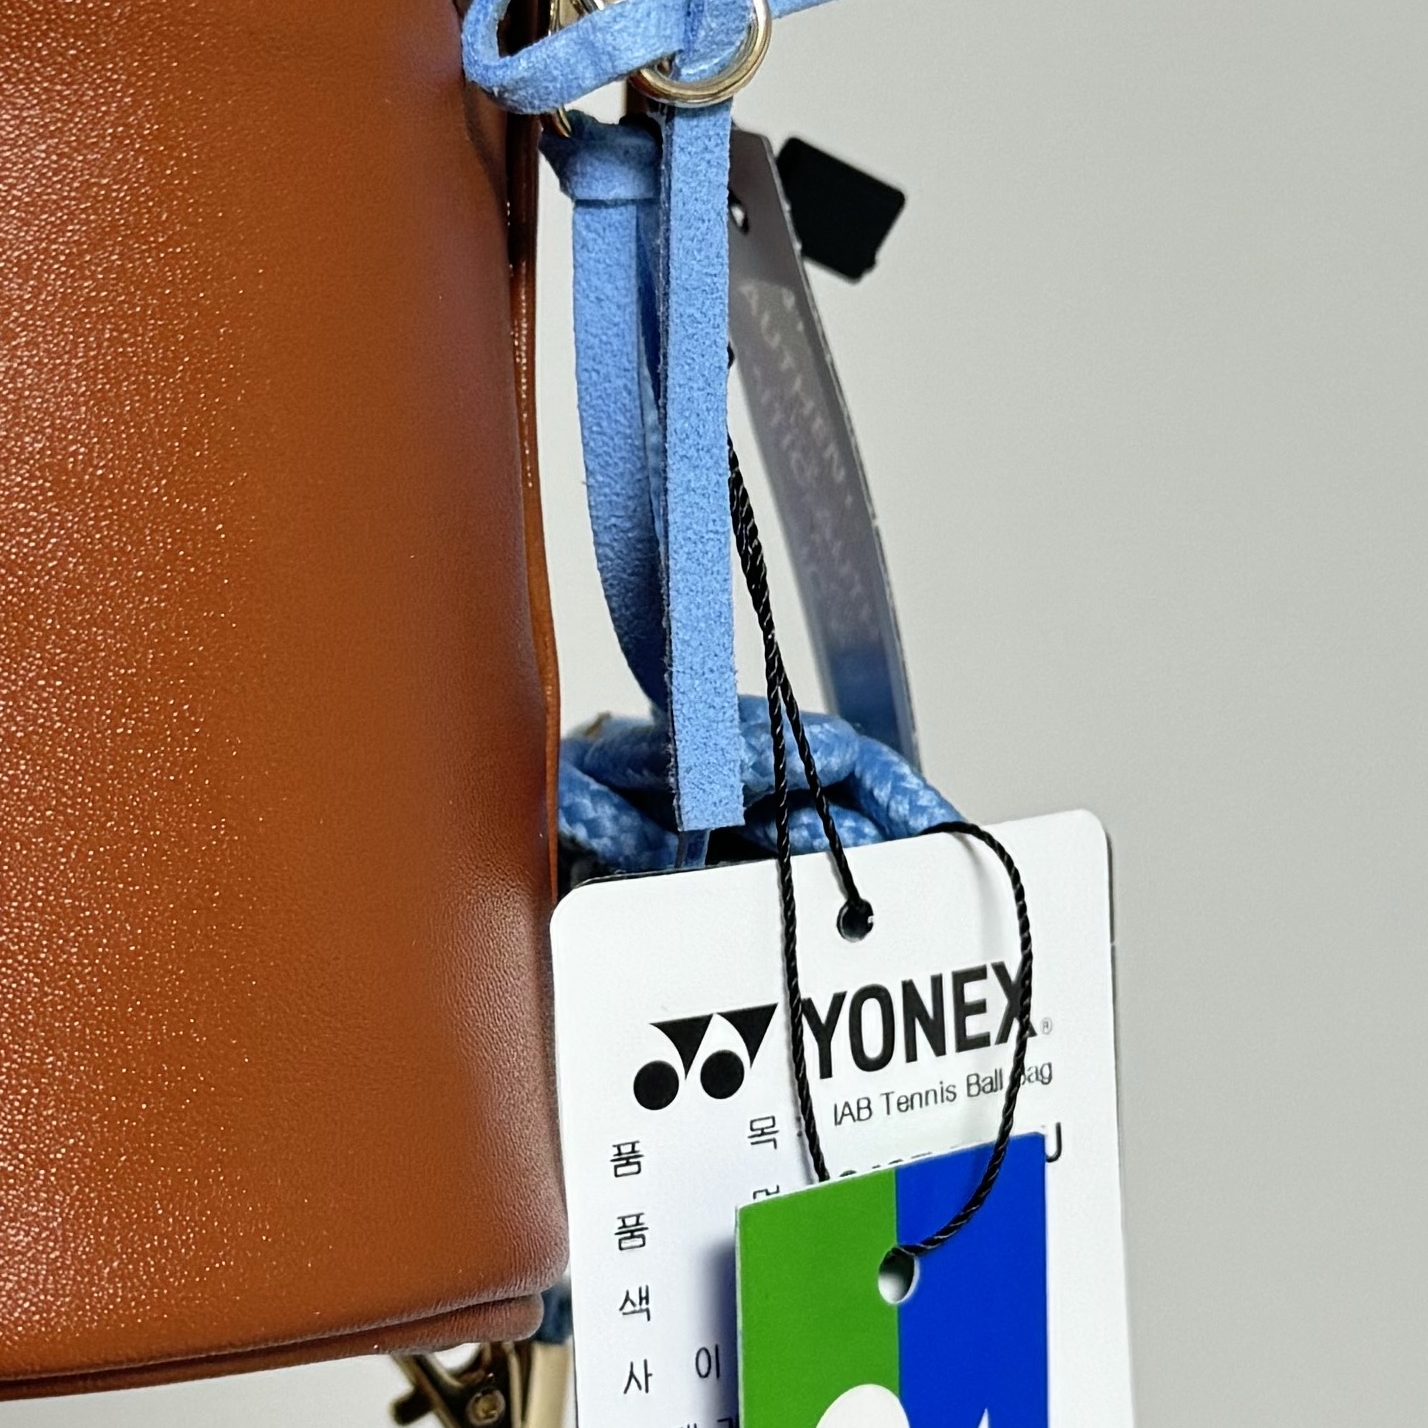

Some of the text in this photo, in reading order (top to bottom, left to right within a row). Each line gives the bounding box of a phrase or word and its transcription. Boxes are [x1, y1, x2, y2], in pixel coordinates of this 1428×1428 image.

[801, 960, 1038, 1080] YONEX
[833, 1062, 1053, 1126] IAB Tennis Ball ag
[610, 1115, 779, 1178] 품 목
[614, 1212, 649, 1251] 품
[618, 1284, 651, 1322] 색
[623, 1358, 653, 1394] 사
